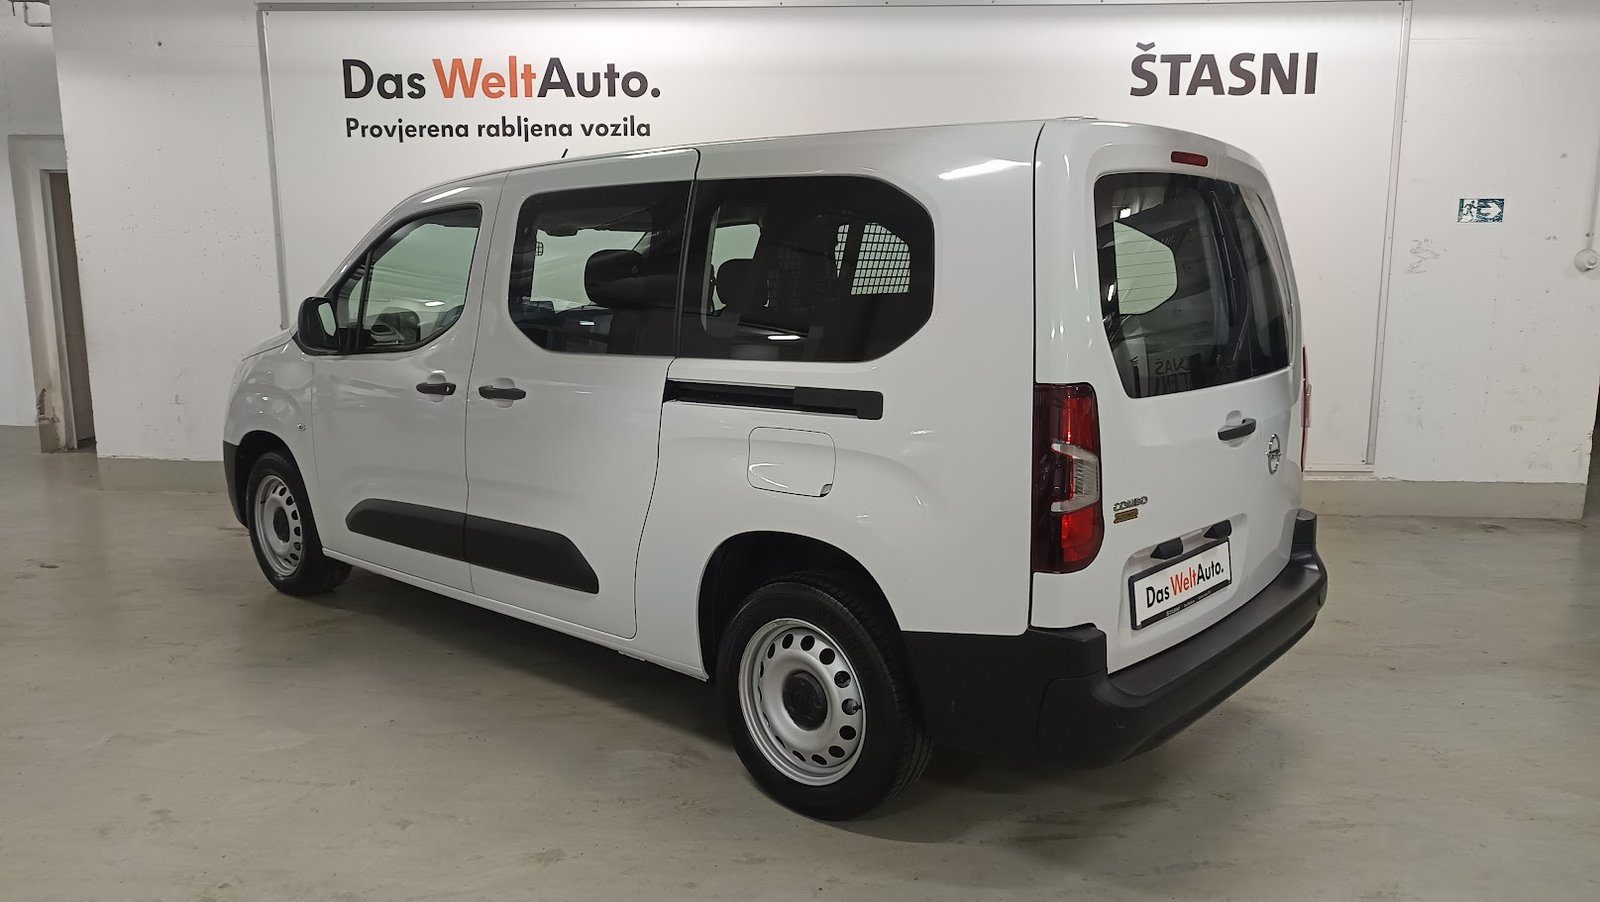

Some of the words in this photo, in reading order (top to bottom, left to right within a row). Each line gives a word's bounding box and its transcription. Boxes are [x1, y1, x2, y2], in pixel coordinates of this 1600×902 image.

[342, 58, 426, 100] Das
[432, 55, 661, 99] WeltAuto.
[1129, 42, 1319, 97] ŠTASNI
[345, 117, 469, 144] Provjerena
[477, 115, 573, 143] rabljena
[580, 115, 651, 137] vozila
[1146, 586, 1170, 609] Das
[1169, 560, 1224, 596] WeltAuto.
